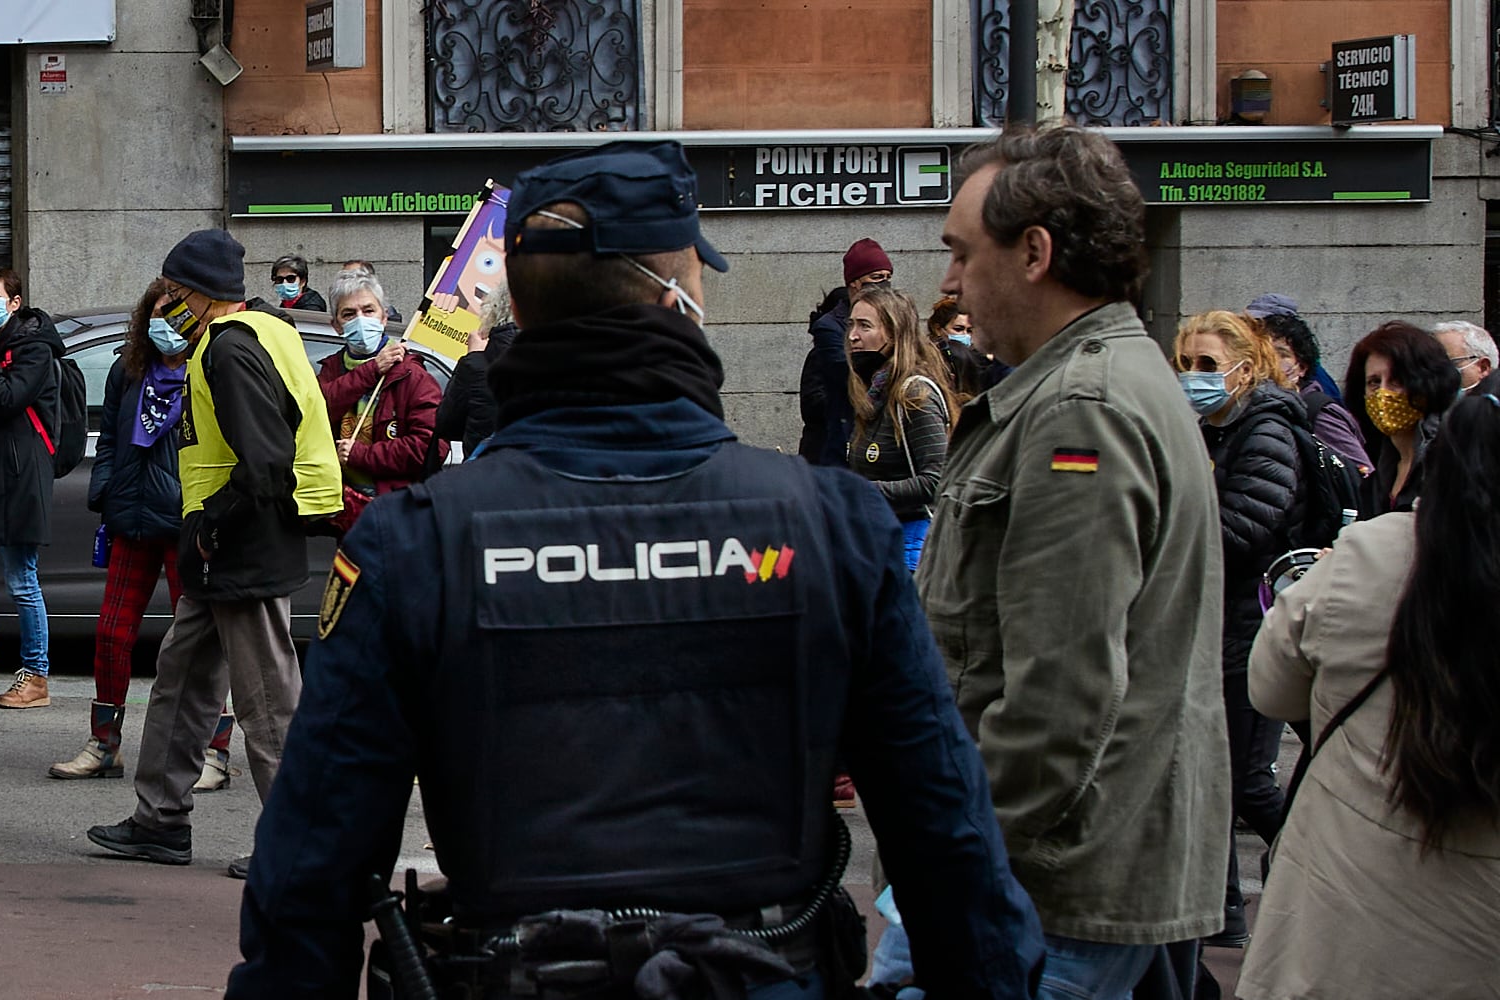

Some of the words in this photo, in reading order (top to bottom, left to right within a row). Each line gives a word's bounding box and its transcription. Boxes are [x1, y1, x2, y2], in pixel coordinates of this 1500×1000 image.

[1337, 46, 1391, 67] SERVICIO
[1338, 69, 1389, 90] TÉCNICO
[1351, 94, 1377, 117] 24H.
[755, 147, 828, 175] POINT
[833, 146, 893, 174] FORT
[1160, 161, 1223, 179] A.Atocha
[1225, 161, 1300, 180] Seguridad
[1302, 160, 1328, 178] S.A.
[1160, 185, 1186, 202] Tfn.
[1188, 184, 1267, 201] 914291882
[483, 537, 758, 585] POLICIA
